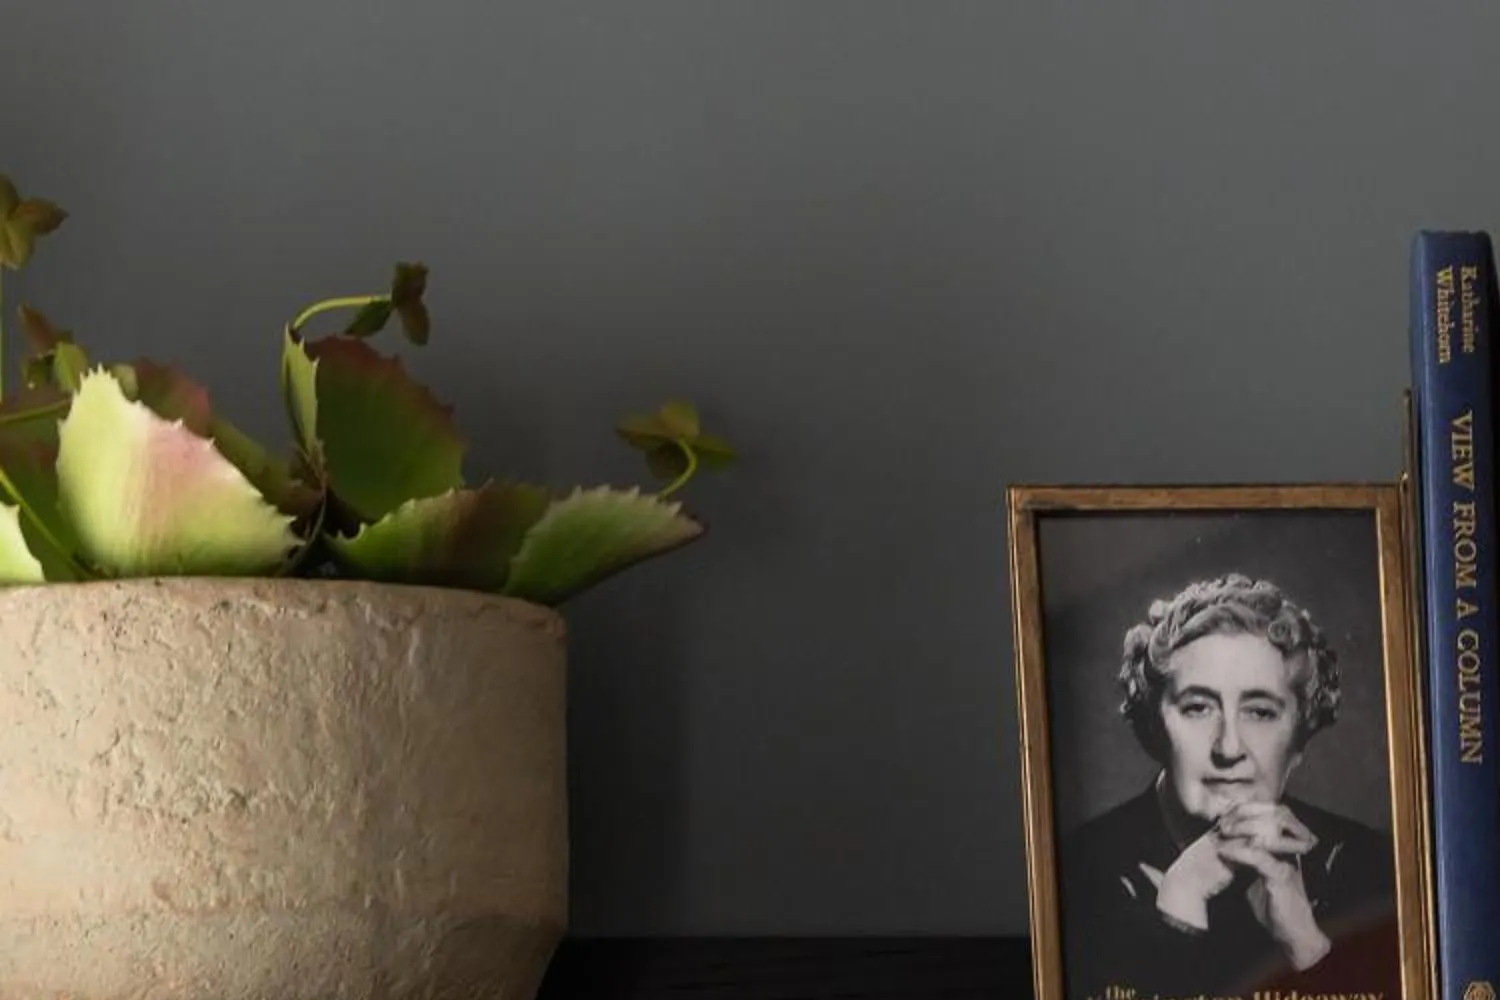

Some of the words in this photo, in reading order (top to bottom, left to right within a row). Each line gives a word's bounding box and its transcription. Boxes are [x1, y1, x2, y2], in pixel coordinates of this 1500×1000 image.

[1449, 410, 1475, 490] VIEW
[1453, 503, 1478, 588] FROM
[1455, 598, 1480, 619] A
[1457, 630, 1484, 765] COLUMN
[1106, 984, 1137, 1000] the
